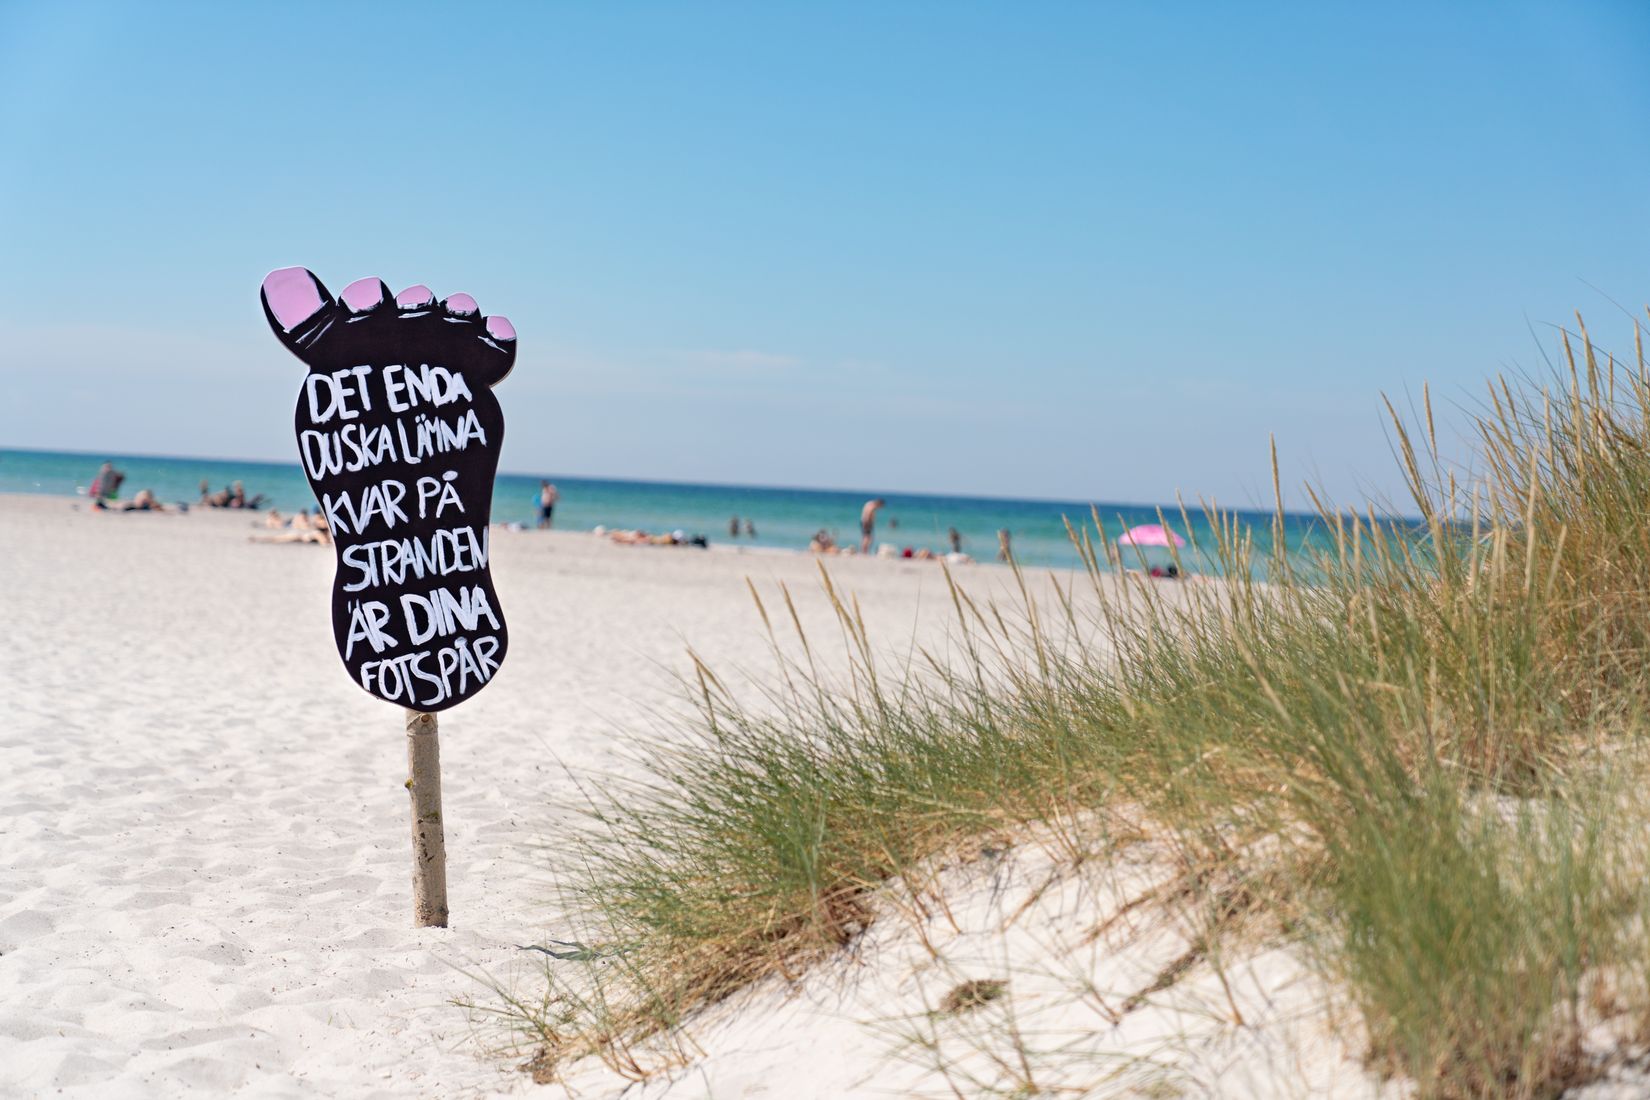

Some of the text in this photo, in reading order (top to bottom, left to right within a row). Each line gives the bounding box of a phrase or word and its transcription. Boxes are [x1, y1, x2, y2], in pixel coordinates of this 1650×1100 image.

[306, 363, 473, 423] DET ENDA
[322, 470, 465, 536] KVAR PÅ
[342, 526, 489, 592] STRANDEN
[345, 584, 500, 661] ÄR DINA
[360, 636, 500, 706] FOTSPÅR
